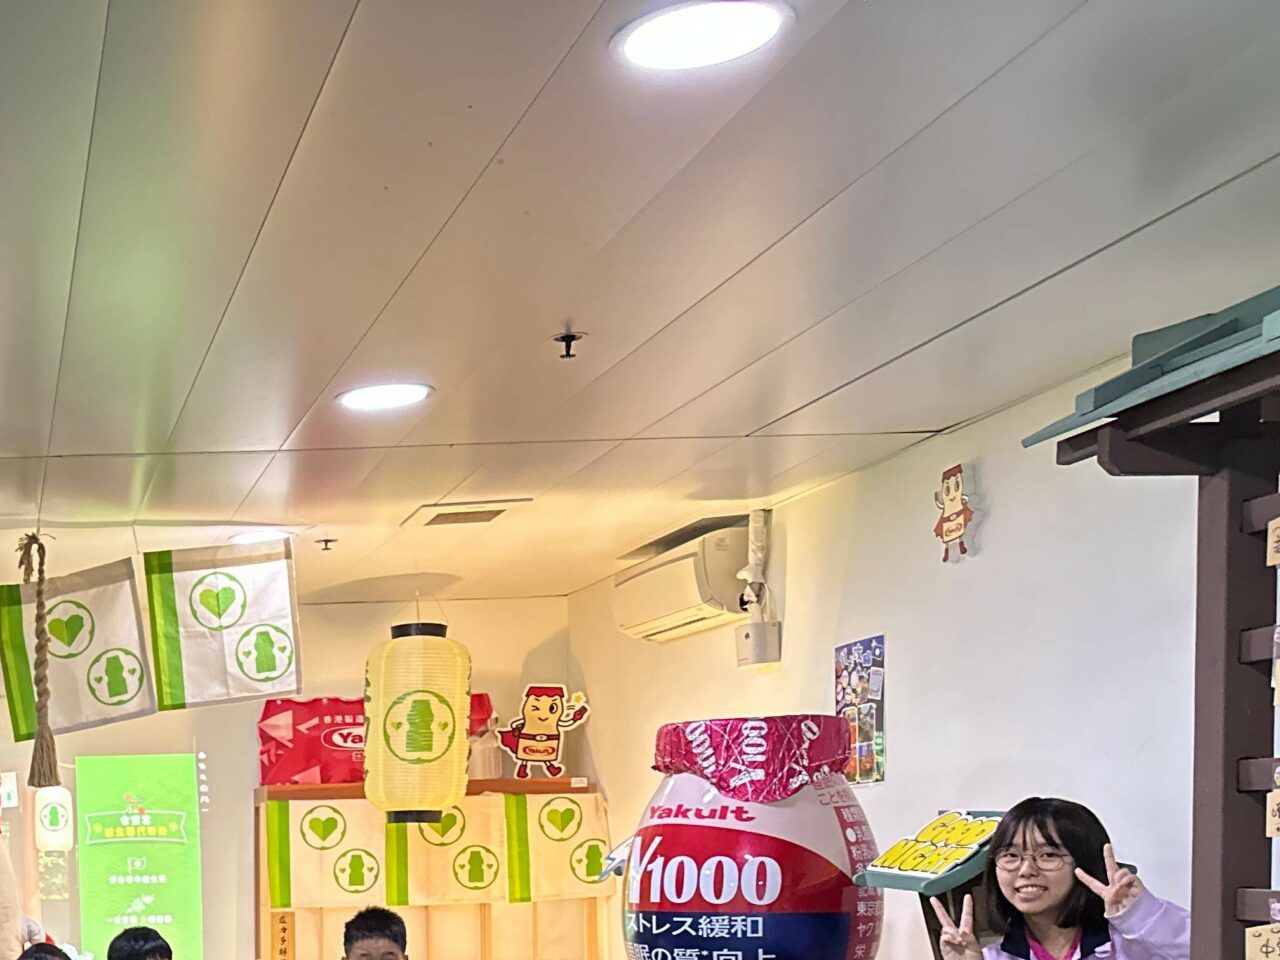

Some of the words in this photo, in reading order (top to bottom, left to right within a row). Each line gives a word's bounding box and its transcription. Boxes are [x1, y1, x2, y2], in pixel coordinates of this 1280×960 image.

[649, 803, 756, 823] Yakult
[915, 811, 999, 846] GOOD
[628, 836, 782, 905] Y1000
[870, 839, 974, 874] NIGHT
[627, 913, 763, 938] ストレス緩和
